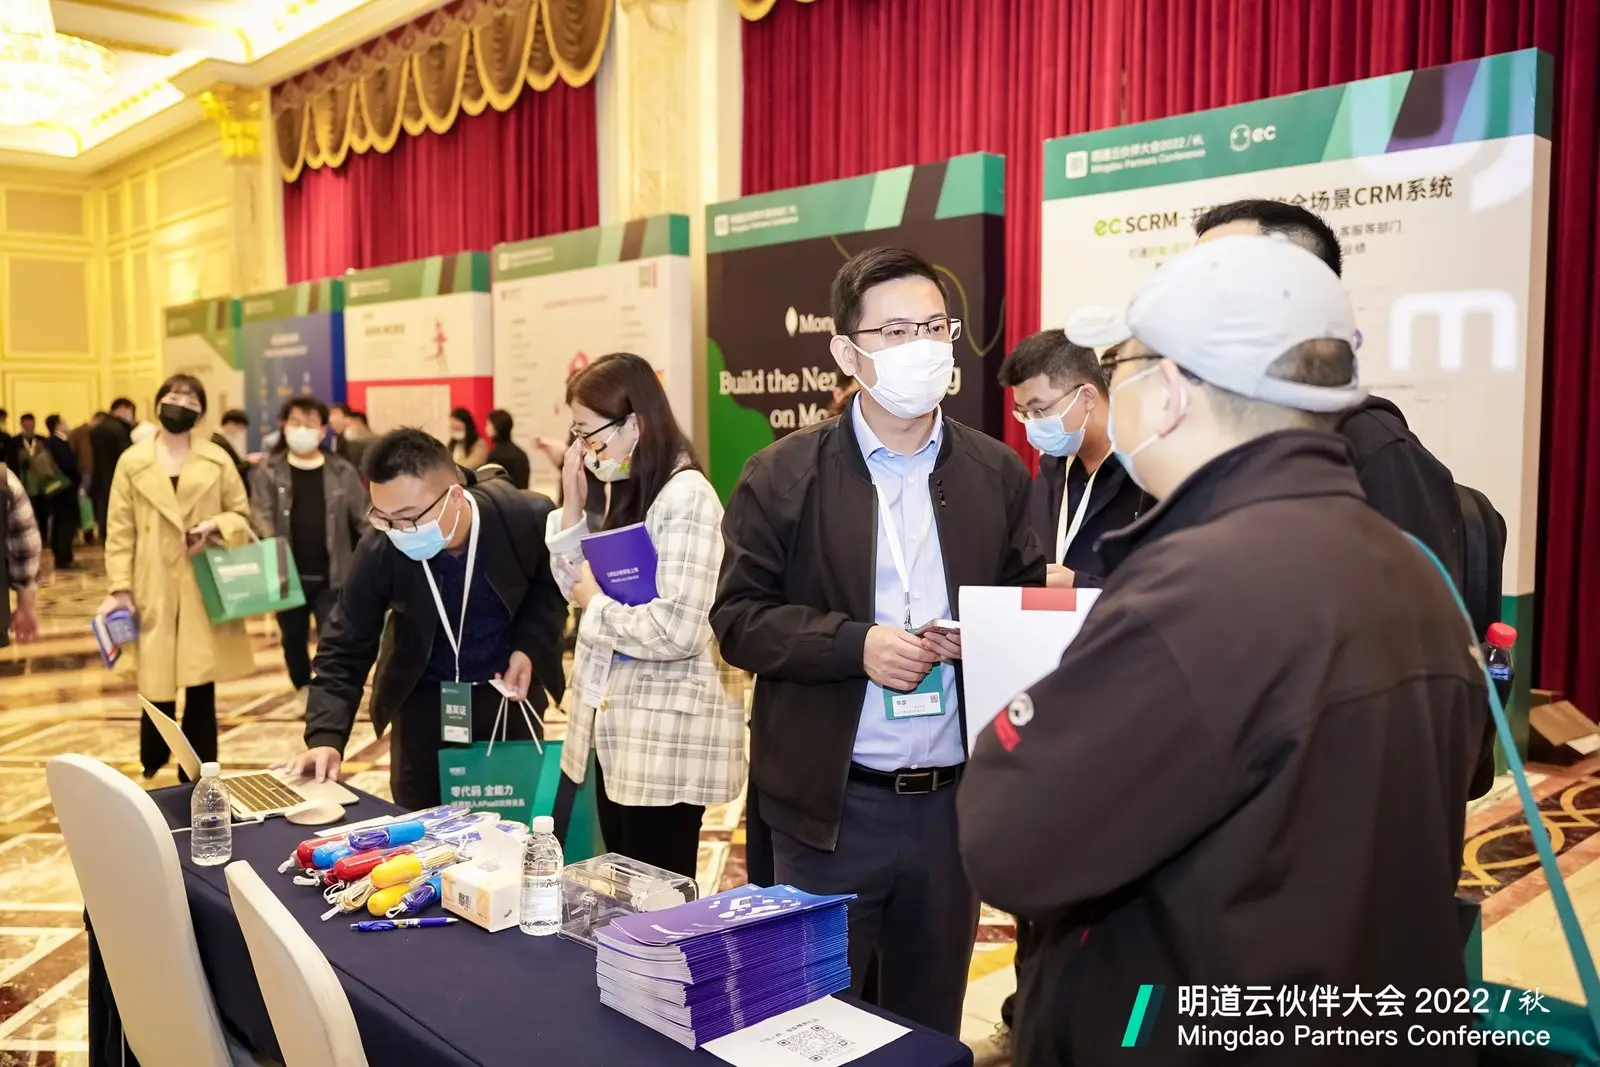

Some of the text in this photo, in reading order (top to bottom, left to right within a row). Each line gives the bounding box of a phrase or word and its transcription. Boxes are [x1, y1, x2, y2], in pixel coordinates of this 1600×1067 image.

[719, 369, 764, 395] Build
[766, 368, 799, 393] the
[769, 407, 795, 429] on
[450, 784, 514, 798] 零代码 全能力
